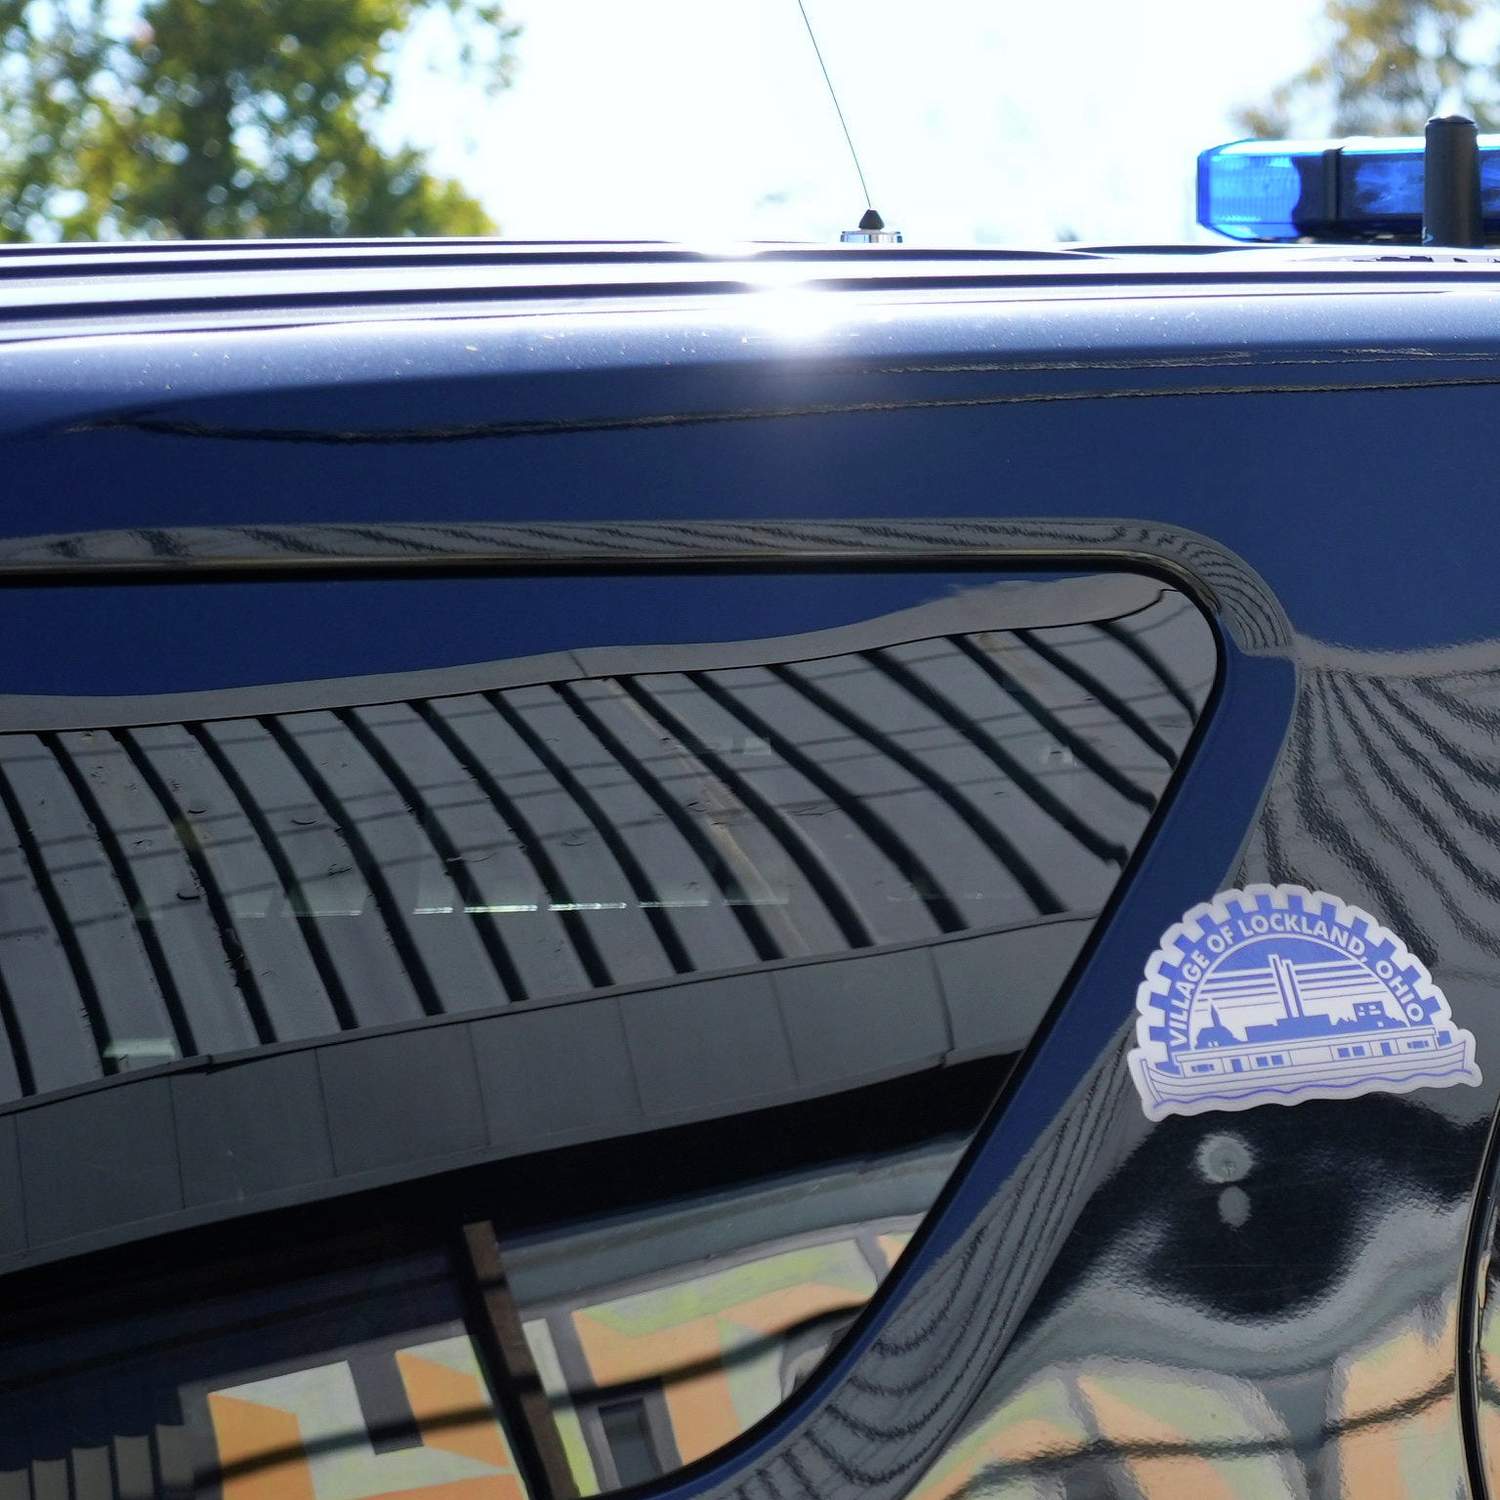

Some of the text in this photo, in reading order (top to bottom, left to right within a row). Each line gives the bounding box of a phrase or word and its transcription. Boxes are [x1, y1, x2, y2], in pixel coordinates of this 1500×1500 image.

[1168, 913, 1425, 1048] VILLAGE OF LOCKLAND, OHIO
